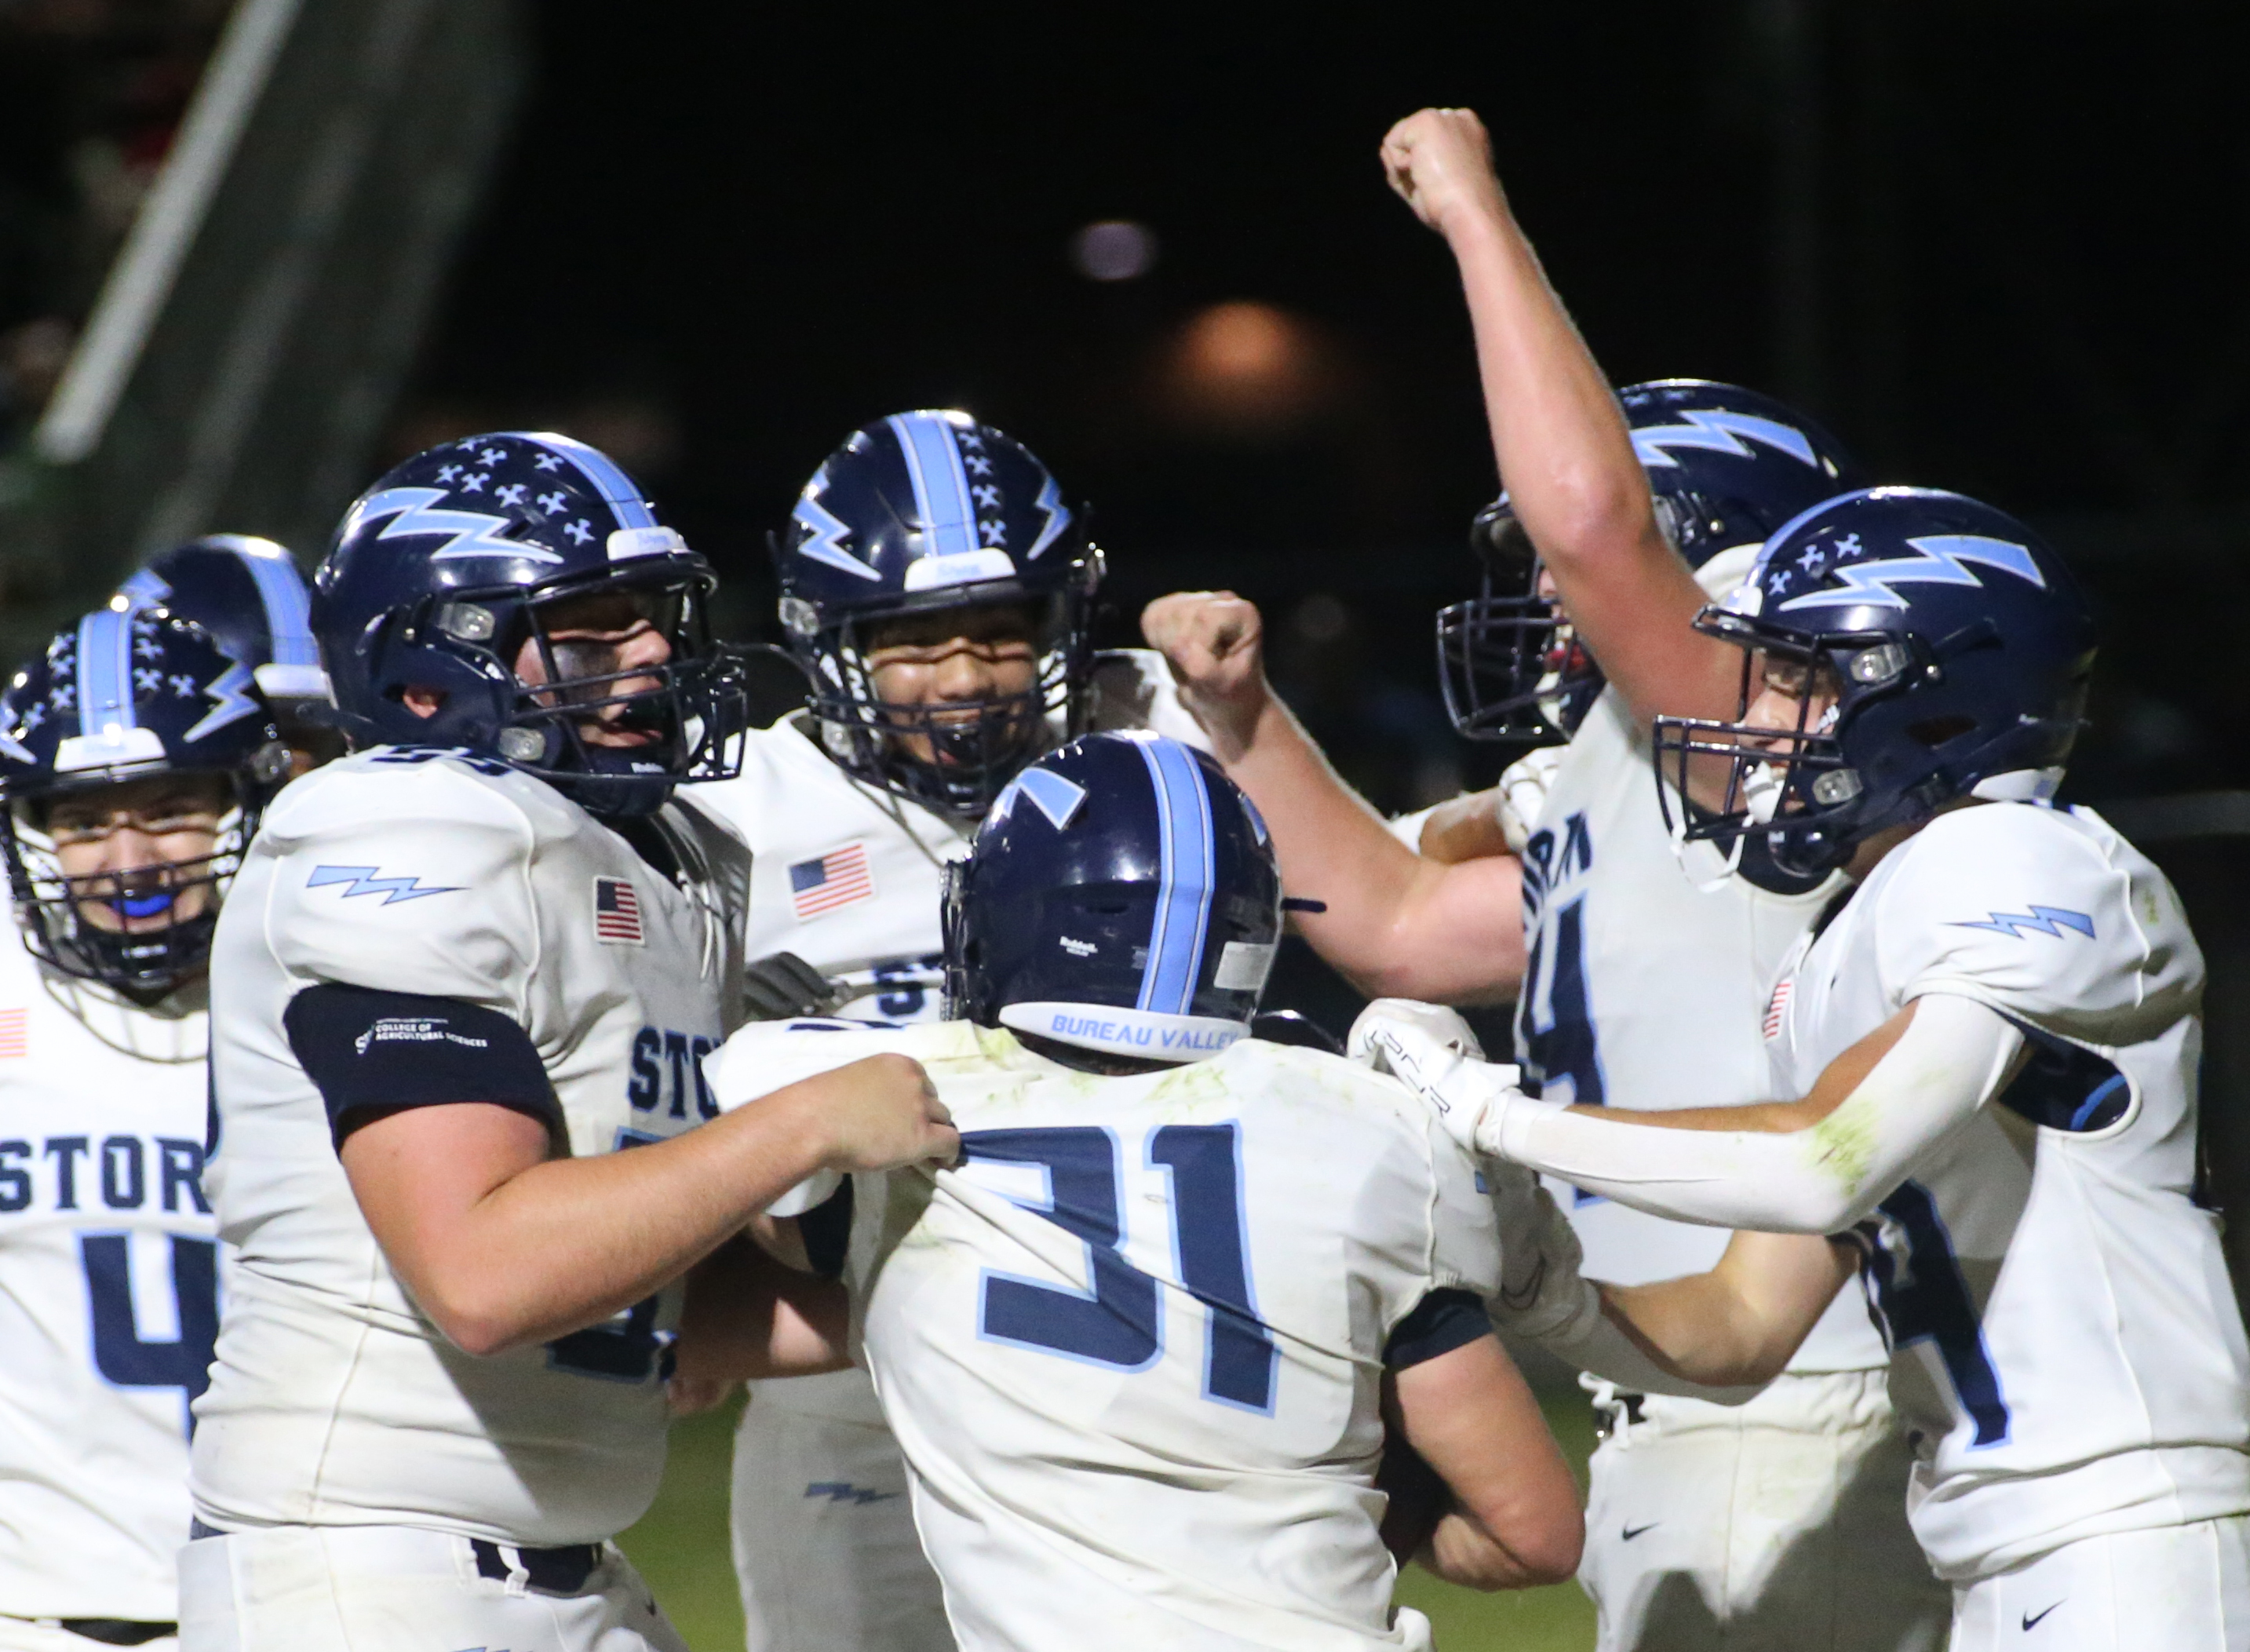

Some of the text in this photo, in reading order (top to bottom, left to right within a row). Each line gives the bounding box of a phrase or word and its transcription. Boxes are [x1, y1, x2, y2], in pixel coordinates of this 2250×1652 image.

[626, 1026, 720, 1122] STO
[1052, 1015, 1240, 1050] BUREAU VALLEY
[74, 1228, 223, 1453] 4
[957, 1118, 1283, 1420] 31
